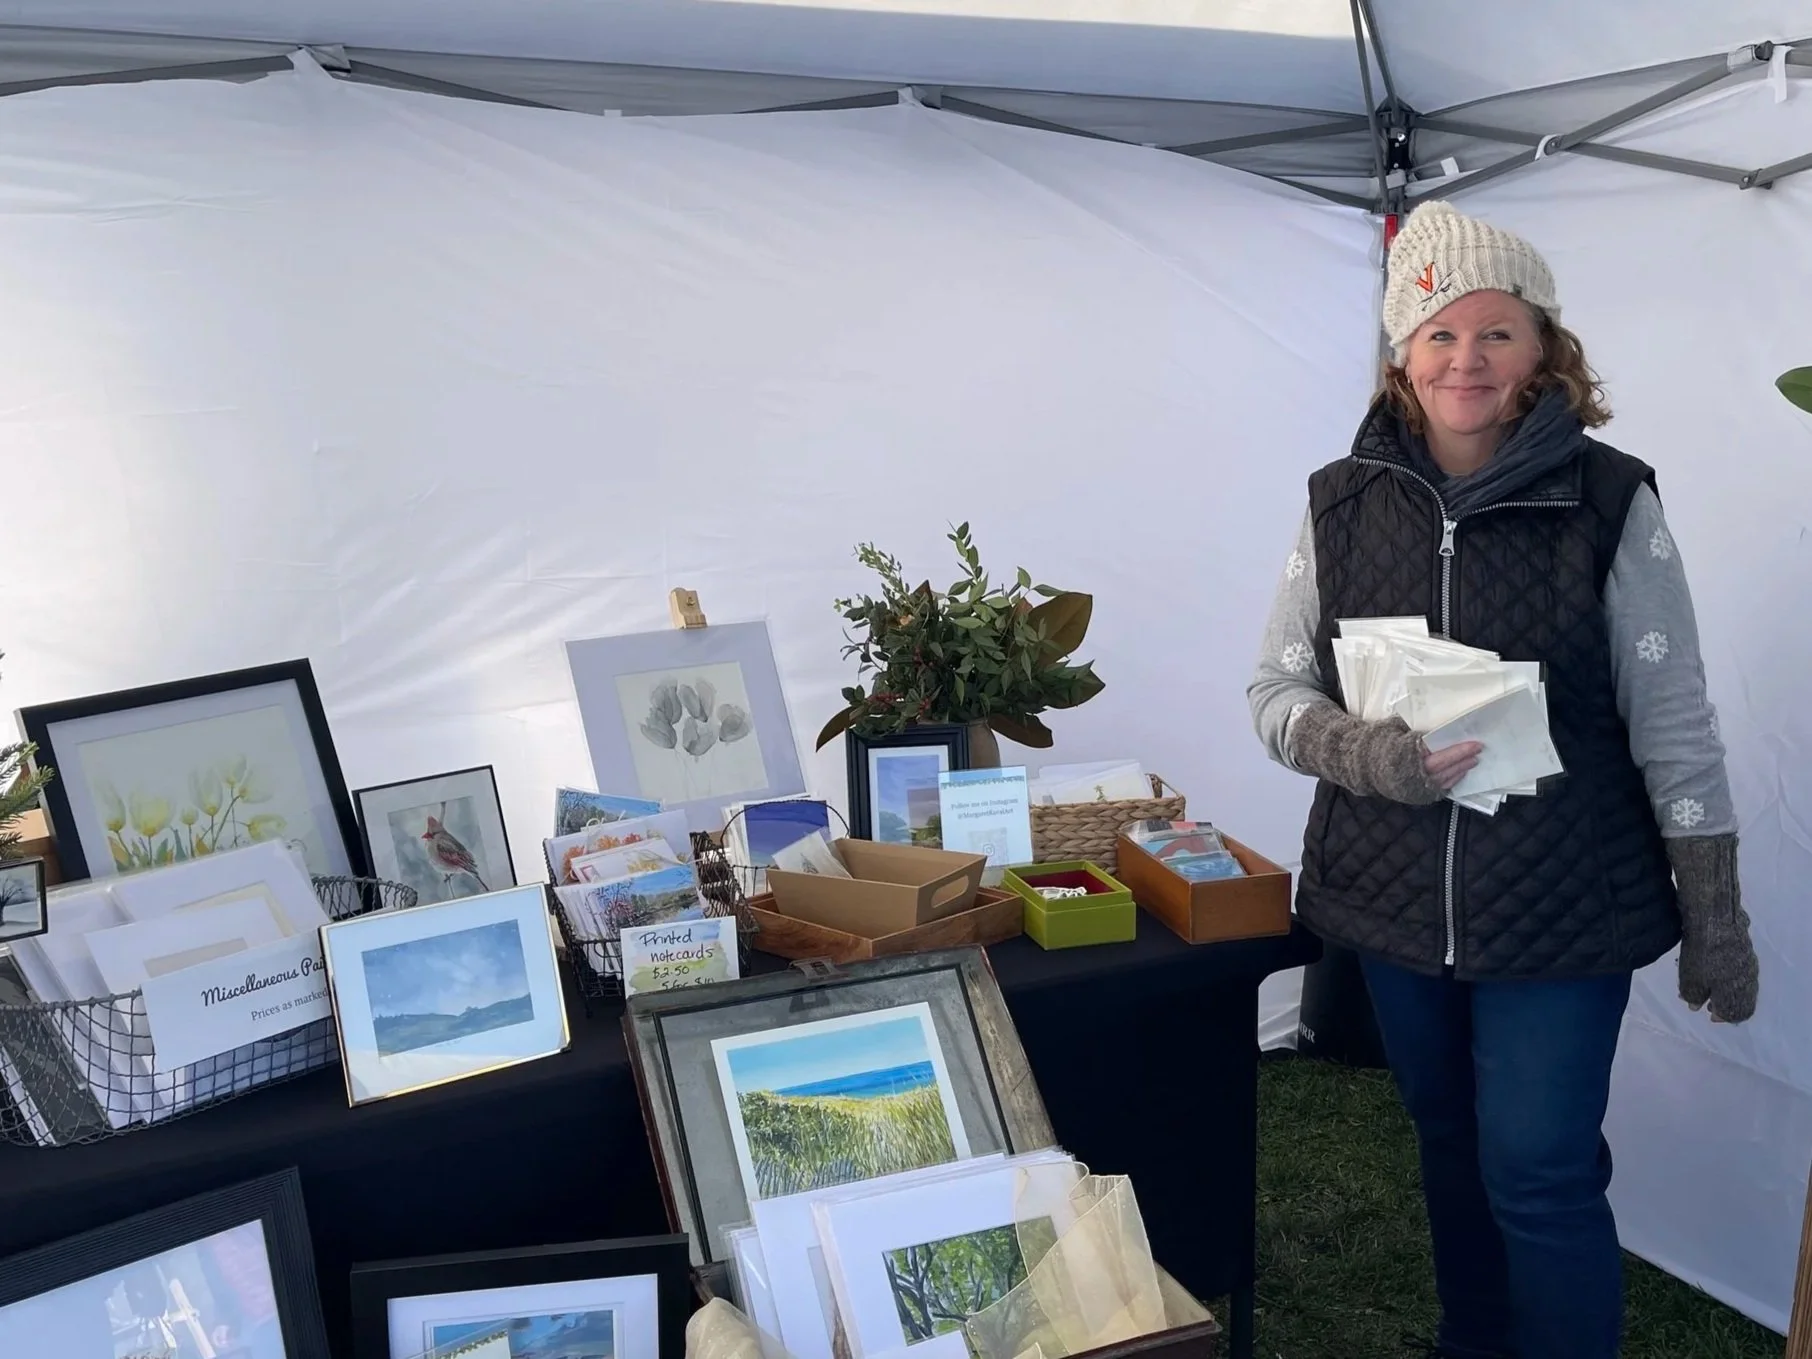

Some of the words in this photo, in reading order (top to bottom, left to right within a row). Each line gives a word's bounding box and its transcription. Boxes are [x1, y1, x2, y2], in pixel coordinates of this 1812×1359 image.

[640, 928, 693, 946] Printed
[651, 943, 715, 963] notecards
[653, 966, 690, 979] $2.50
[201, 967, 300, 1007] Miscellaneous
[251, 1004, 281, 1021] Prices
[282, 1001, 293, 1011] as
[294, 987, 329, 1007] marked
